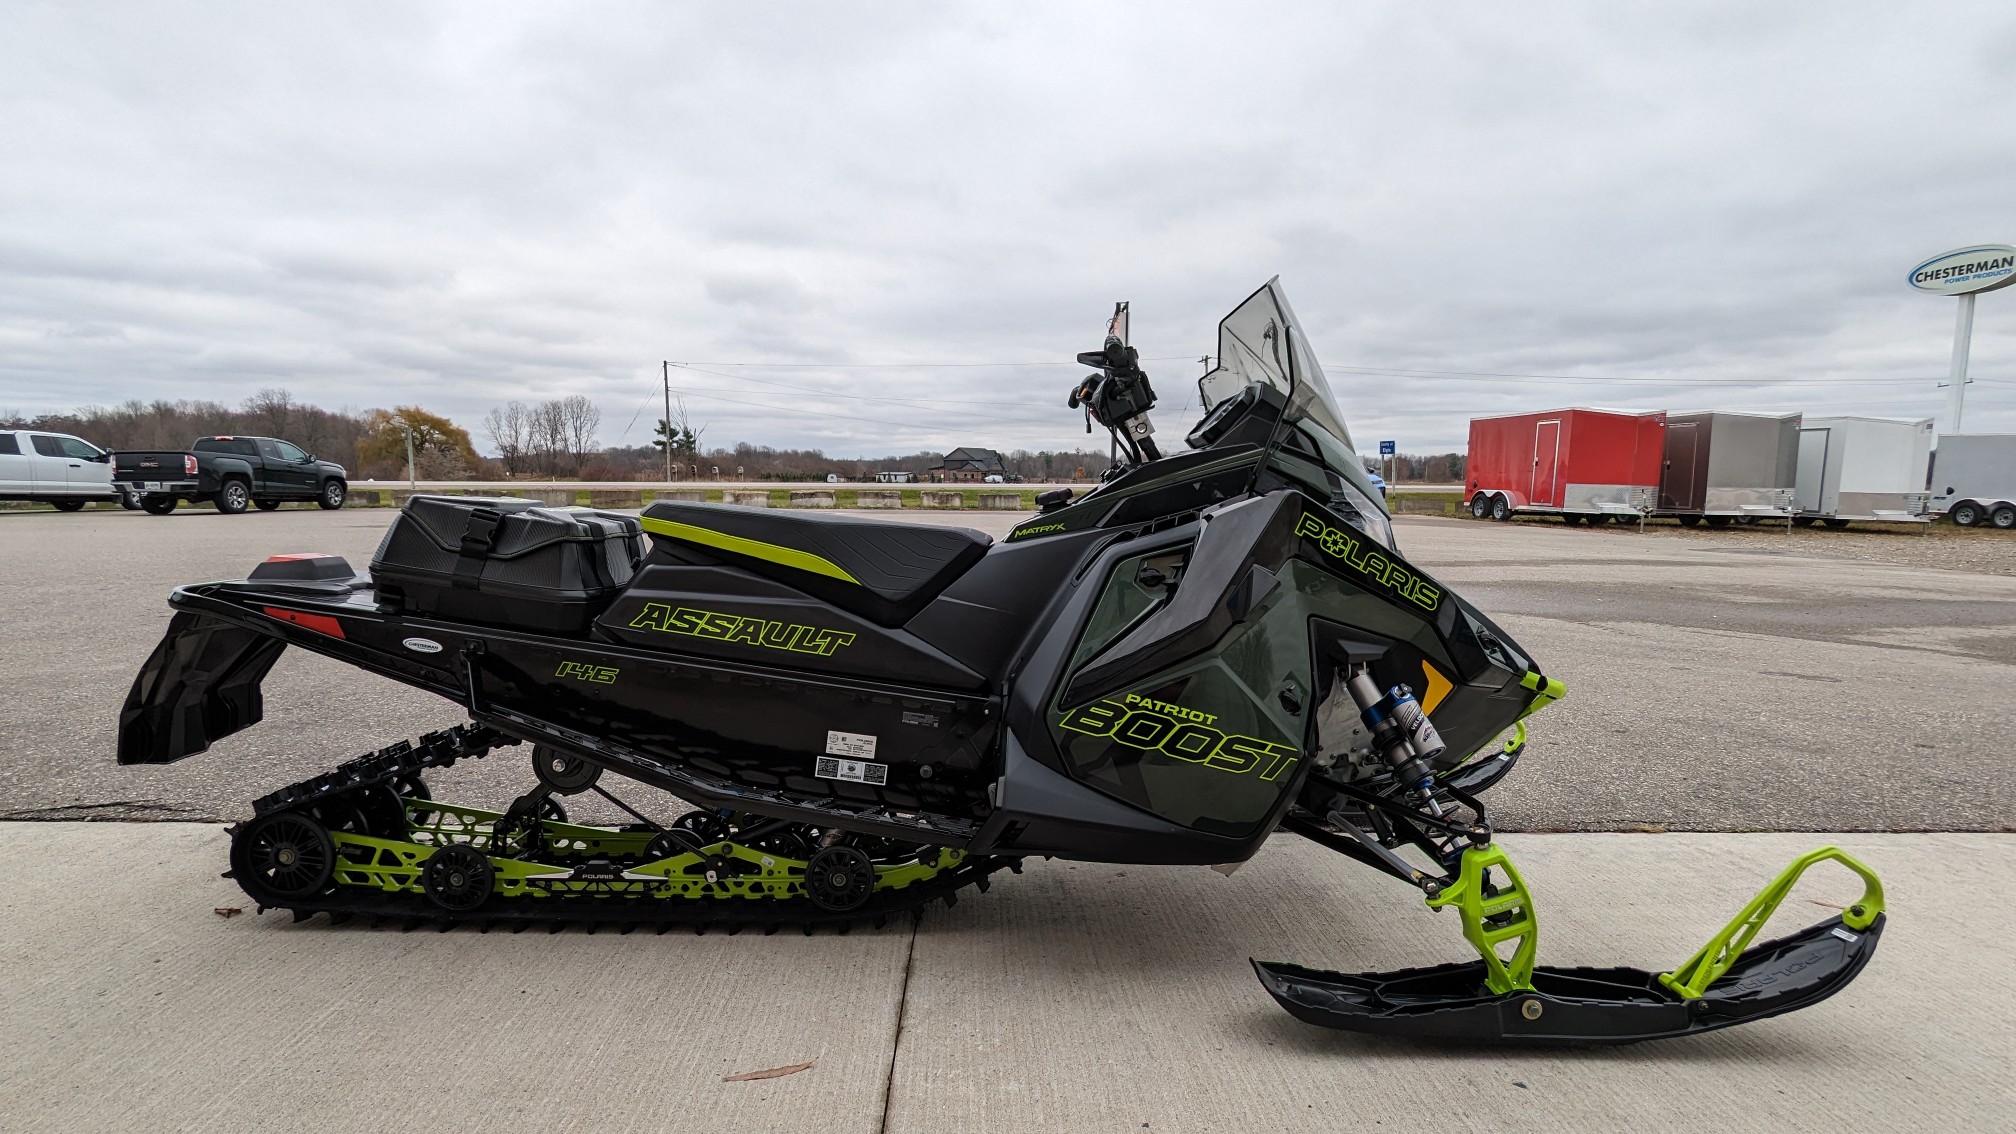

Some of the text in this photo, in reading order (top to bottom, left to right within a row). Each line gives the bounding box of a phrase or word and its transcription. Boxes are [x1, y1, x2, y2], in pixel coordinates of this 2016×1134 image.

[1915, 256, 2014, 282] CHESTERMAN
[1944, 267, 2014, 284] POWER PRODUCTS
[1014, 523, 1067, 539] MATRYX
[1294, 511, 1440, 611] POLARIS
[629, 602, 857, 656] ASSAULT
[555, 661, 619, 684] 146
[1125, 693, 1218, 725] PATRIOT
[1059, 699, 1299, 781] BOOST
[1483, 897, 1523, 914] POLARIS
[1718, 951, 1825, 996] POLARIS
